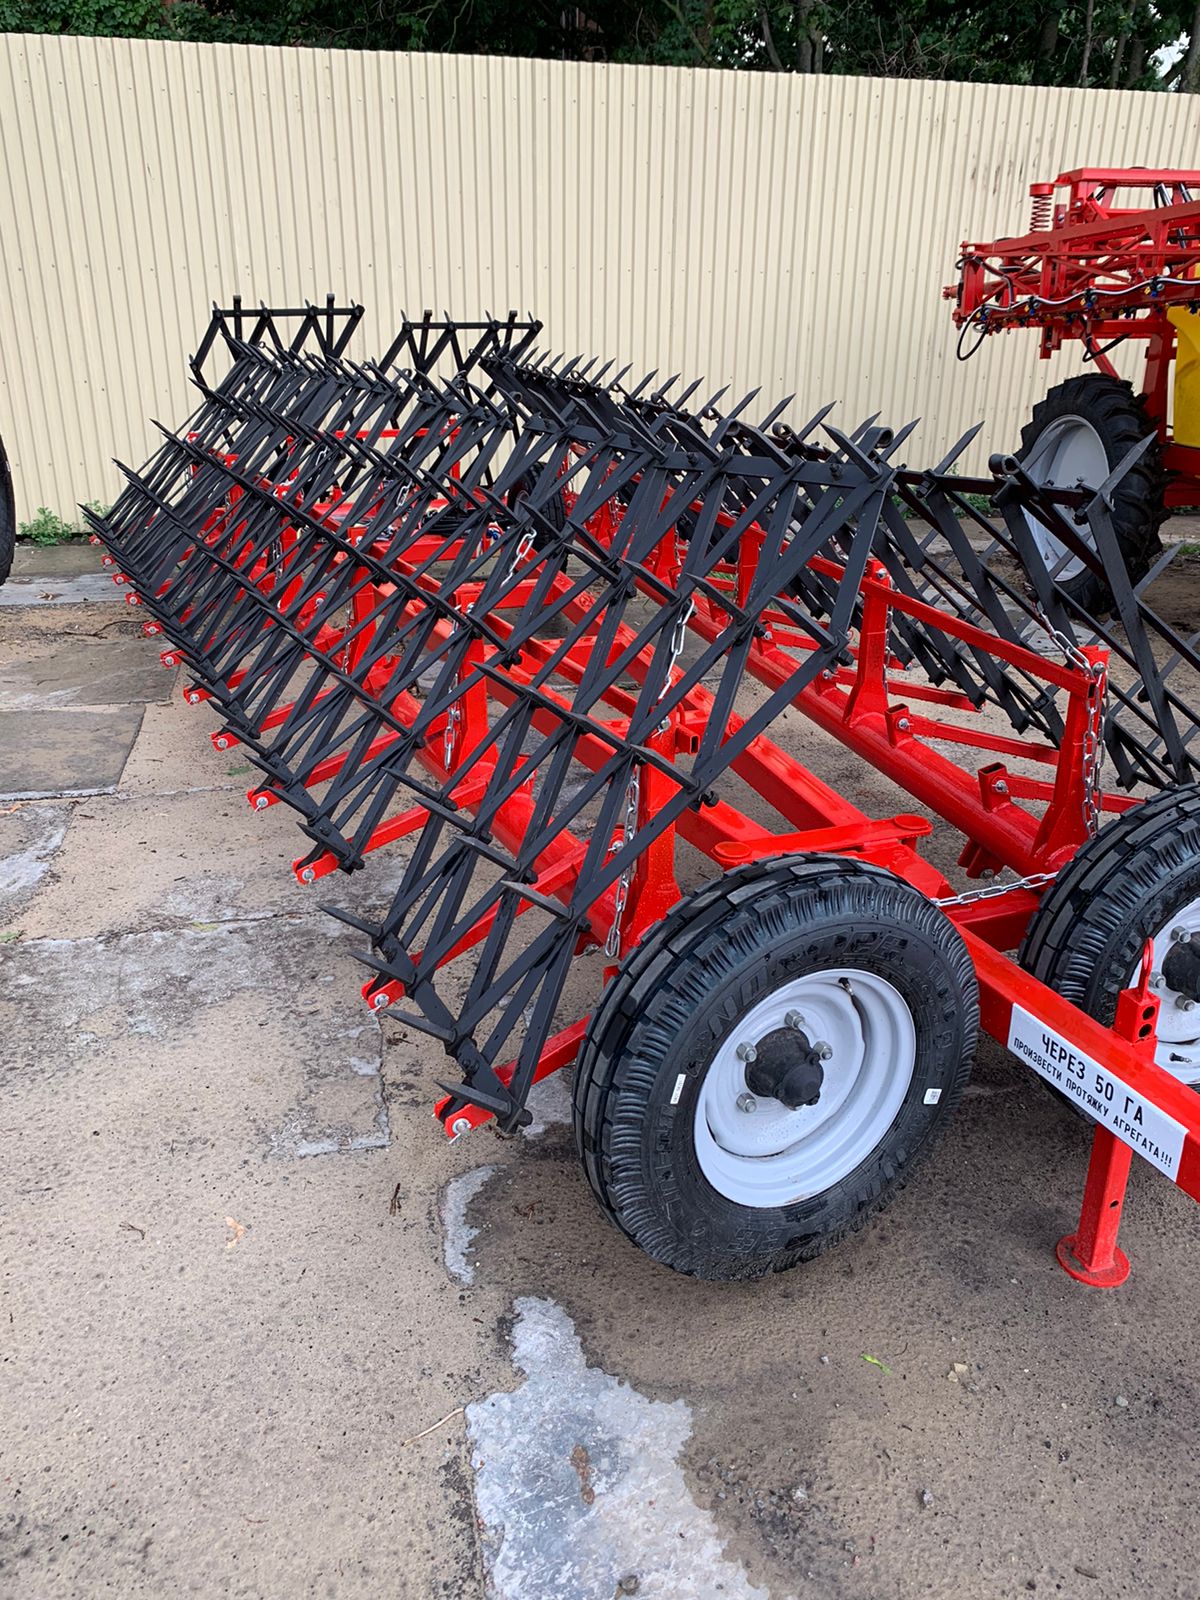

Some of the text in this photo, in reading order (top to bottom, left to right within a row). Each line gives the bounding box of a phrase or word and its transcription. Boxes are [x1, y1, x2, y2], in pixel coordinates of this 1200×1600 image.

[1014, 1037, 1172, 1168] ПРОИЗВЕСТИ ПРОТЯЖКУ АГРЕГАТА!!!
[1042, 1033, 1143, 1126] ЧЕРЕЗ 50 ГА
